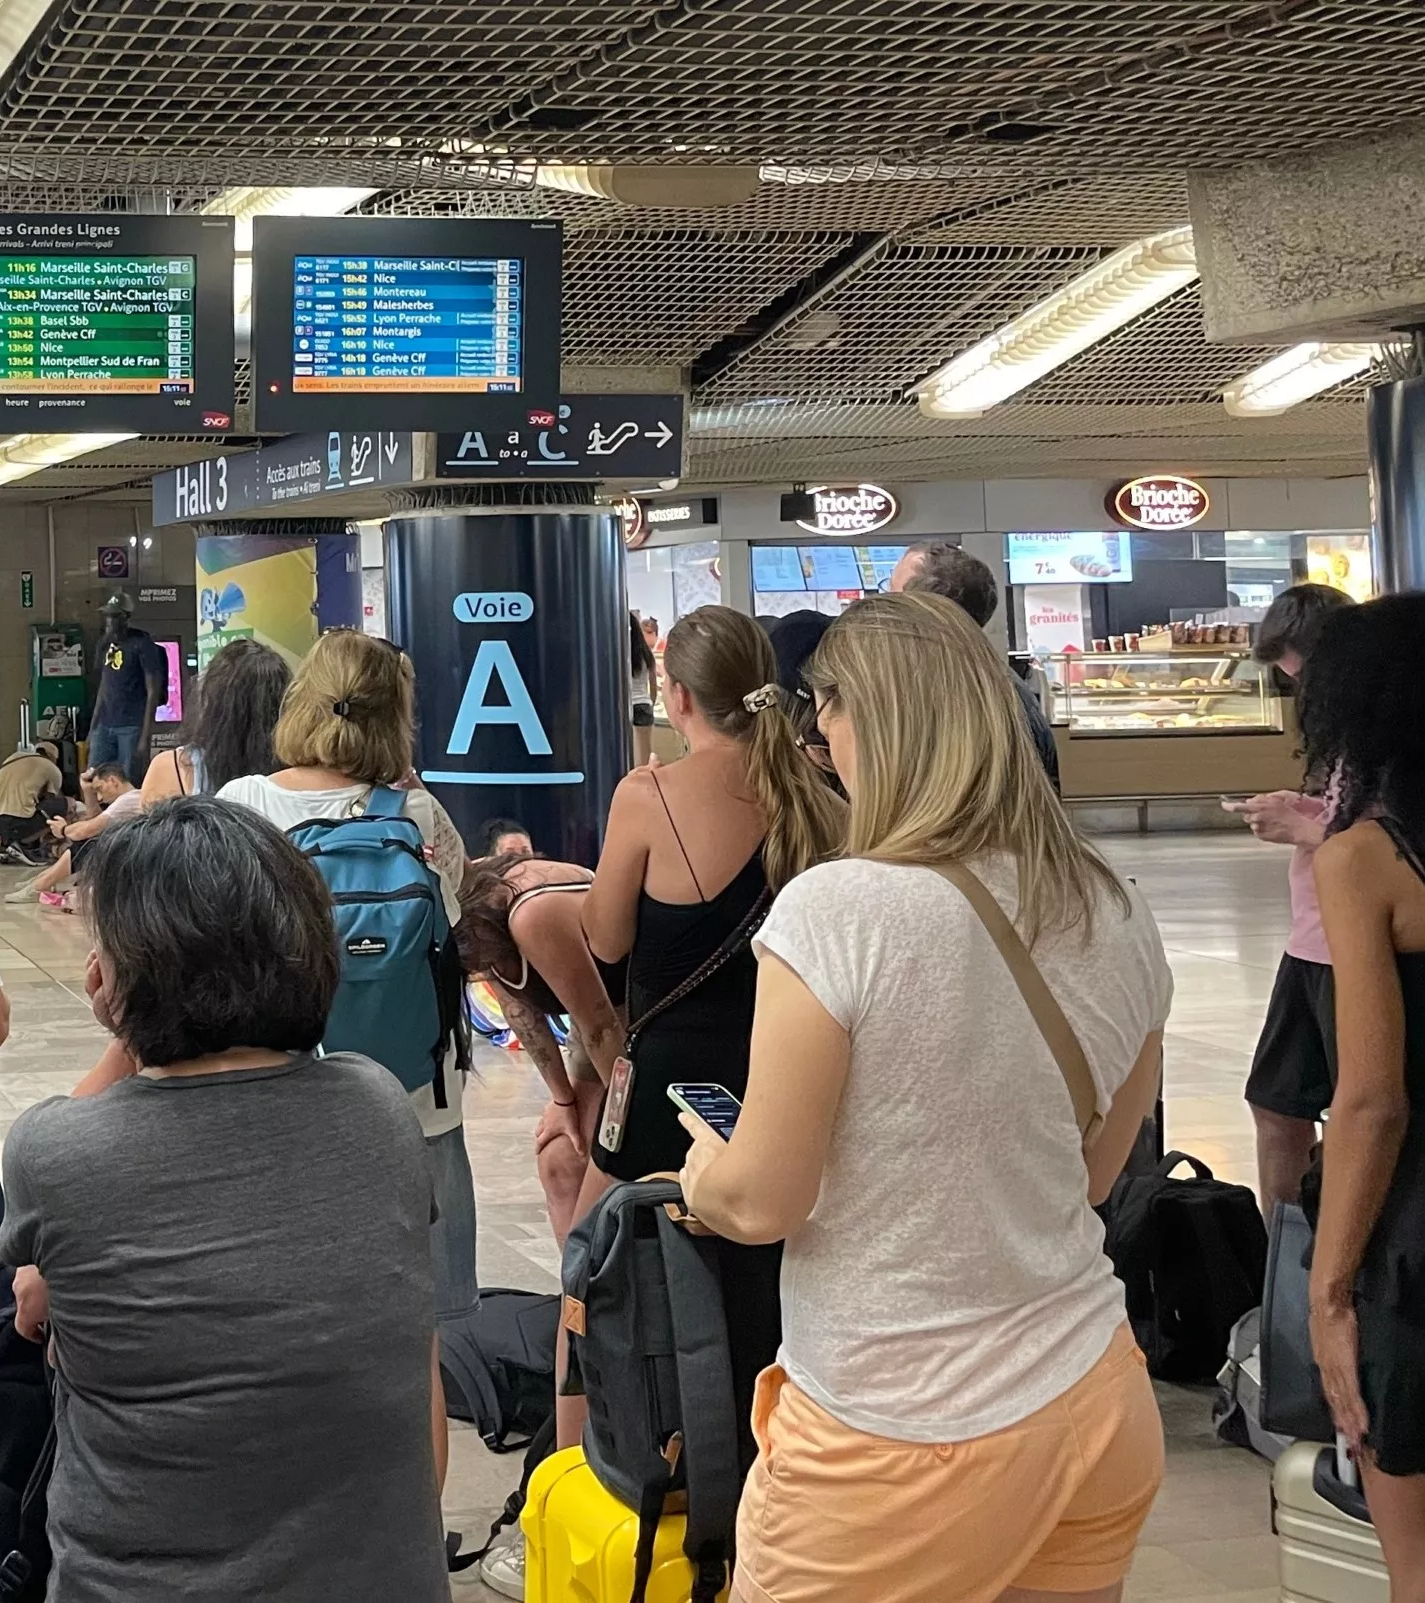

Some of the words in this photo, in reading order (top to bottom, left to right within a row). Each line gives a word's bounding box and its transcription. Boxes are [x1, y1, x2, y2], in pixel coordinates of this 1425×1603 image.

[16, 223, 73, 235] Grandes
[77, 223, 121, 238] Lignes
[7, 263, 36, 272] 11h16
[40, 262, 91, 273] Marseille
[94, 262, 168, 273] Saint-Charles
[374, 261, 417, 271] Marseille
[28, 275, 95, 285] Saint-Charles
[103, 276, 143, 288] Avignon
[146, 276, 167, 285] TGV
[342, 274, 367, 283] 15h42
[374, 273, 396, 283] Nice
[7, 290, 37, 299] 13h34
[40, 289, 91, 300] Marseille
[94, 289, 168, 300] Saint-Charles
[373, 286, 427, 296] Montereau
[81, 302, 103, 312] TGV
[110, 302, 150, 314] Avignon
[153, 302, 174, 312] TGV
[373, 300, 434, 310] Malesherbes
[7, 317, 34, 325] 13h38
[40, 316, 67, 326] Basel
[69, 316, 89, 326] Sbb
[373, 313, 397, 325] Lyon
[399, 313, 442, 323] Perrache
[7, 330, 34, 339] 13h42
[40, 329, 78, 339] Genève
[80, 329, 96, 339] Cff
[341, 327, 367, 336] 16h07
[373, 327, 422, 338] Montargis
[40, 342, 64, 352] Nice
[341, 340, 367, 349] 16h10
[373, 339, 395, 349] Nice
[7, 357, 34, 366] 13h54
[40, 356, 99, 368] Montpellier
[101, 356, 120, 366] Sud
[122, 356, 135, 366] de
[137, 356, 160, 366] Fran
[372, 353, 409, 363] Genève
[411, 353, 426, 362] Cff
[67, 370, 111, 379] Perrache
[372, 366, 409, 376] Genève
[411, 366, 426, 375] Cff
[5, 398, 29, 406] heure
[38, 399, 86, 408] provenance
[173, 398, 191, 406] voie
[202, 417, 229, 426] SNCF
[528, 415, 554, 424] SNCF
[456, 431, 489, 458] A
[499, 449, 510, 458] to
[266, 463, 286, 485] Accès
[287, 464, 300, 480] aux
[300, 455, 321, 477] trains
[176, 461, 212, 518] Hall
[216, 456, 228, 511] 3
[1130, 484, 1200, 507] Brioche
[1140, 504, 1194, 523] Dorée
[818, 511, 876, 529] Dorée
[1035, 562, 1044, 574] 7
[464, 597, 522, 618] Voie
[1029, 611, 1079, 626] granités
[446, 640, 553, 755] A
